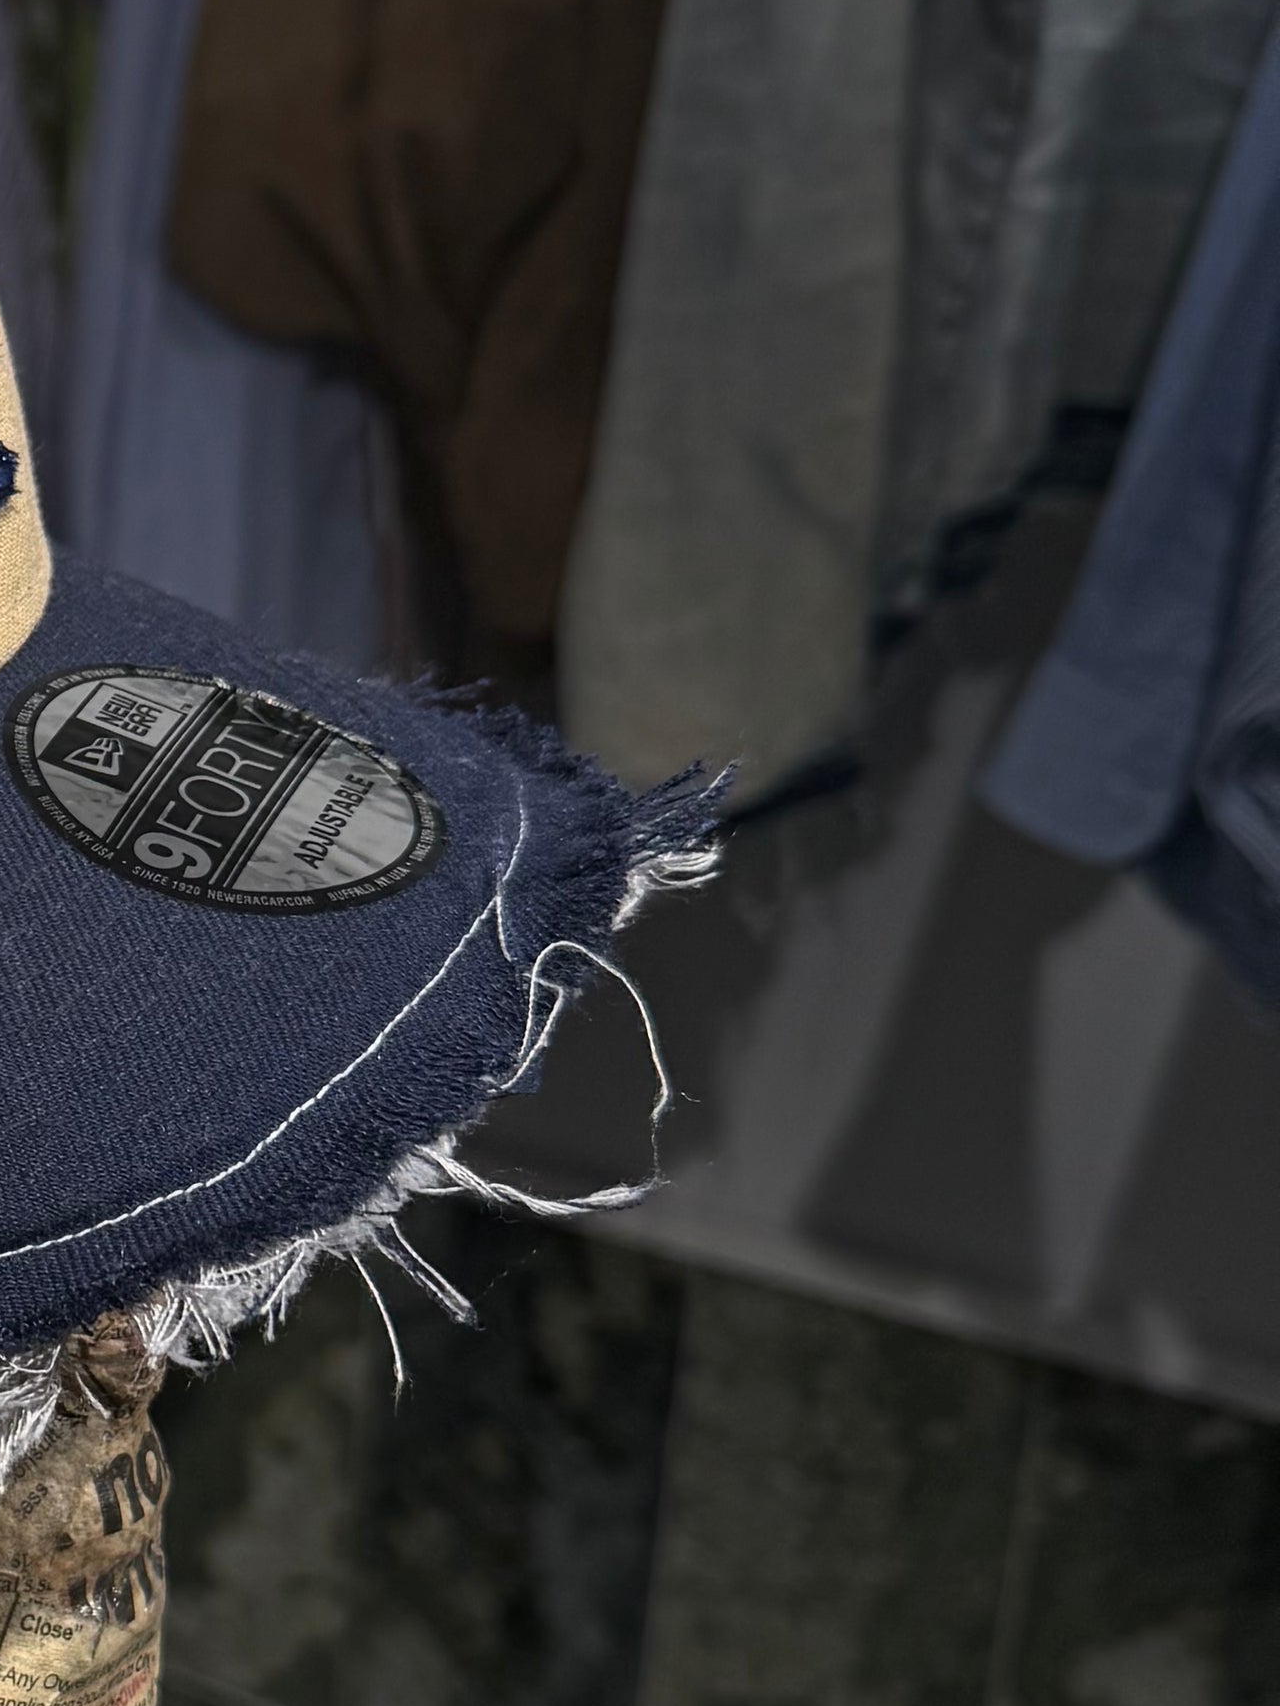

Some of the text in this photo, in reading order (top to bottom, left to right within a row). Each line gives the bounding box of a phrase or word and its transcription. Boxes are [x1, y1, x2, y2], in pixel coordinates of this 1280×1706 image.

[95, 692, 138, 728] NEW
[120, 701, 164, 738] ERA
[133, 701, 300, 879] 9FORTY
[293, 773, 376, 870] ADJUSTABLE
[91, 843, 114, 861] USA
[131, 865, 202, 897] SINCE 1920
[207, 888, 316, 907] NEWERACAP.COM
[0, 1666, 39, 1690] Any
